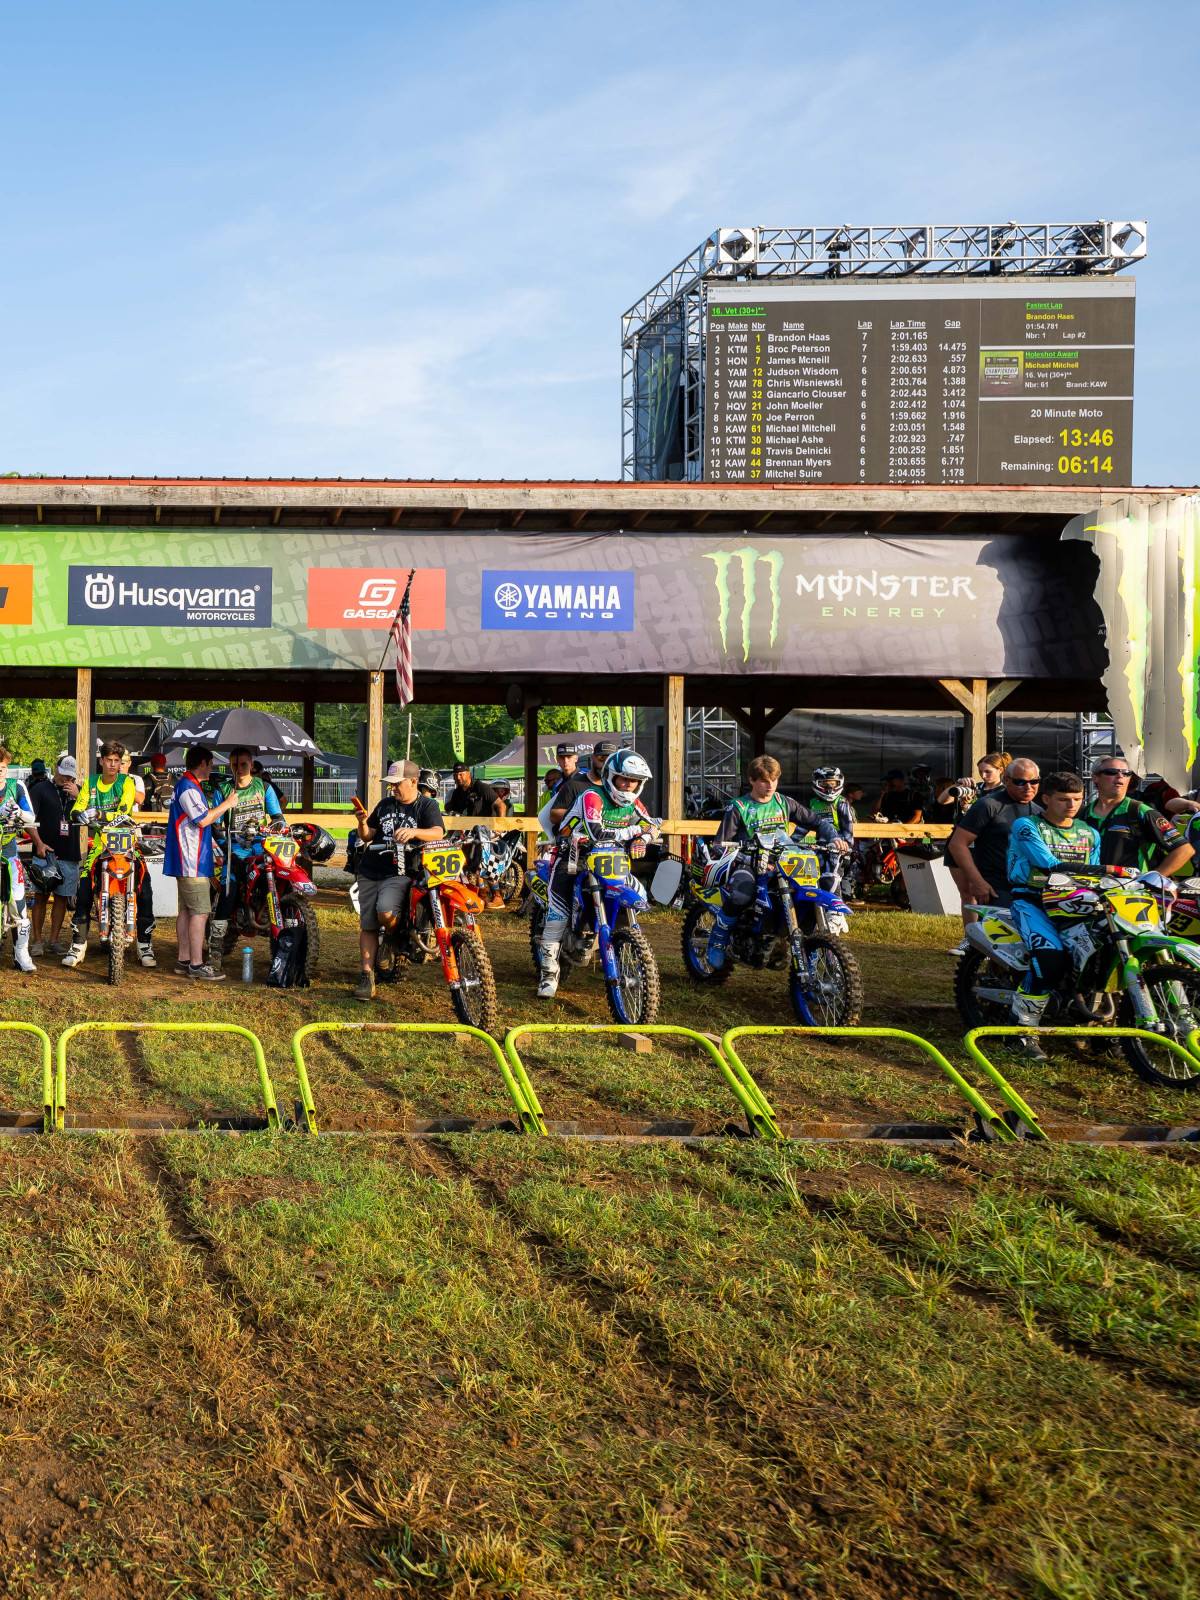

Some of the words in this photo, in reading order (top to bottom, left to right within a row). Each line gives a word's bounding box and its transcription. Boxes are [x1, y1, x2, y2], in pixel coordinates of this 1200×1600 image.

[712, 307, 723, 316] 16.
[725, 307, 738, 315] Vet
[1025, 302, 1050, 310] Fastest
[1050, 302, 1063, 310] Lap
[710, 323, 725, 332] Pos
[727, 322, 749, 332] Make
[751, 322, 766, 332] Nbr
[782, 321, 805, 332] Name
[857, 320, 873, 330] Lap
[889, 320, 905, 330] Lap
[907, 320, 927, 329] Time
[944, 319, 962, 329] Gap
[767, 334, 806, 343] Brandon
[808, 333, 831, 342] Haas
[891, 332, 928, 341] 2:01.165
[767, 345, 789, 354] Broc
[791, 344, 831, 353] Peterson
[891, 343, 928, 352] 1:59.403
[938, 343, 967, 352] 14.475
[766, 356, 797, 365] James
[798, 355, 830, 364] Mcneill
[890, 355, 928, 364] 2:02.633
[948, 354, 967, 363] .557
[1025, 351, 1056, 359] Holeshot
[1057, 351, 1079, 359] Award
[1025, 361, 1052, 369] Michael
[766, 368, 800, 377] Judson
[801, 367, 839, 376] Wisdom
[890, 366, 927, 375] 2:00.651
[942, 366, 967, 375] 4.873
[766, 379, 791, 388] Chris
[793, 378, 843, 387] Wisniewski
[890, 378, 928, 387] 2:03.764
[942, 377, 967, 386] 1.388
[766, 390, 810, 399] Giancarlo
[811, 390, 847, 398] Clouser
[890, 389, 927, 398] 2:02.443
[942, 388, 966, 397] 3.412
[766, 402, 789, 411] John
[790, 401, 824, 410] Moeller
[890, 400, 927, 409] 2:02.412
[942, 400, 966, 409] 1.074
[766, 413, 782, 422] Joe
[784, 413, 815, 422] Perron
[890, 412, 927, 421] 1:59.662
[942, 411, 966, 420] 1.916
[1030, 409, 1042, 418] 20
[1044, 409, 1077, 418] Minute
[1078, 409, 1103, 418] Moto
[765, 425, 800, 434] Michael
[801, 424, 836, 433] Mitchell
[889, 423, 926, 432] 2:03.051
[942, 423, 966, 432] 1.548
[765, 436, 800, 445] Michael
[800, 435, 824, 444] Ashe
[889, 434, 927, 444] 2:02.923
[946, 434, 966, 443] .747
[1013, 435, 1055, 447] Elapsed:
[1059, 428, 1114, 447] 13:46
[766, 447, 794, 456] Travis
[795, 446, 832, 456] Delnicki
[889, 446, 927, 455] 2:00.252
[941, 446, 965, 455] 1.851
[765, 459, 803, 468] Brennan
[805, 458, 832, 469] Myers
[889, 457, 926, 466] 2:03.655
[941, 457, 965, 466] 6.717
[1000, 462, 1054, 473] Remaining:
[1057, 455, 1114, 474] 06:14
[765, 470, 797, 479] Mitchel
[799, 470, 823, 479] Suire
[889, 468, 926, 478] 2:04.055
[941, 468, 965, 477] 1.178
[795, 569, 978, 602] MONSTER
[118, 582, 256, 610] Husqvarna
[523, 584, 622, 610] YAMAHA
[186, 612, 256, 621] MOTORCYCLES
[343, 609, 398, 619] GASGA
[504, 611, 615, 619] RACING
[821, 606, 946, 619] ENERGY
[105, 832, 133, 853] 80
[269, 841, 296, 858] 70
[431, 853, 461, 877] 36
[593, 855, 631, 877] 86
[787, 856, 818, 879] 24
[1124, 896, 1154, 922] 7
[1175, 902, 1199, 915] HOND
[989, 926, 1014, 942] 7
